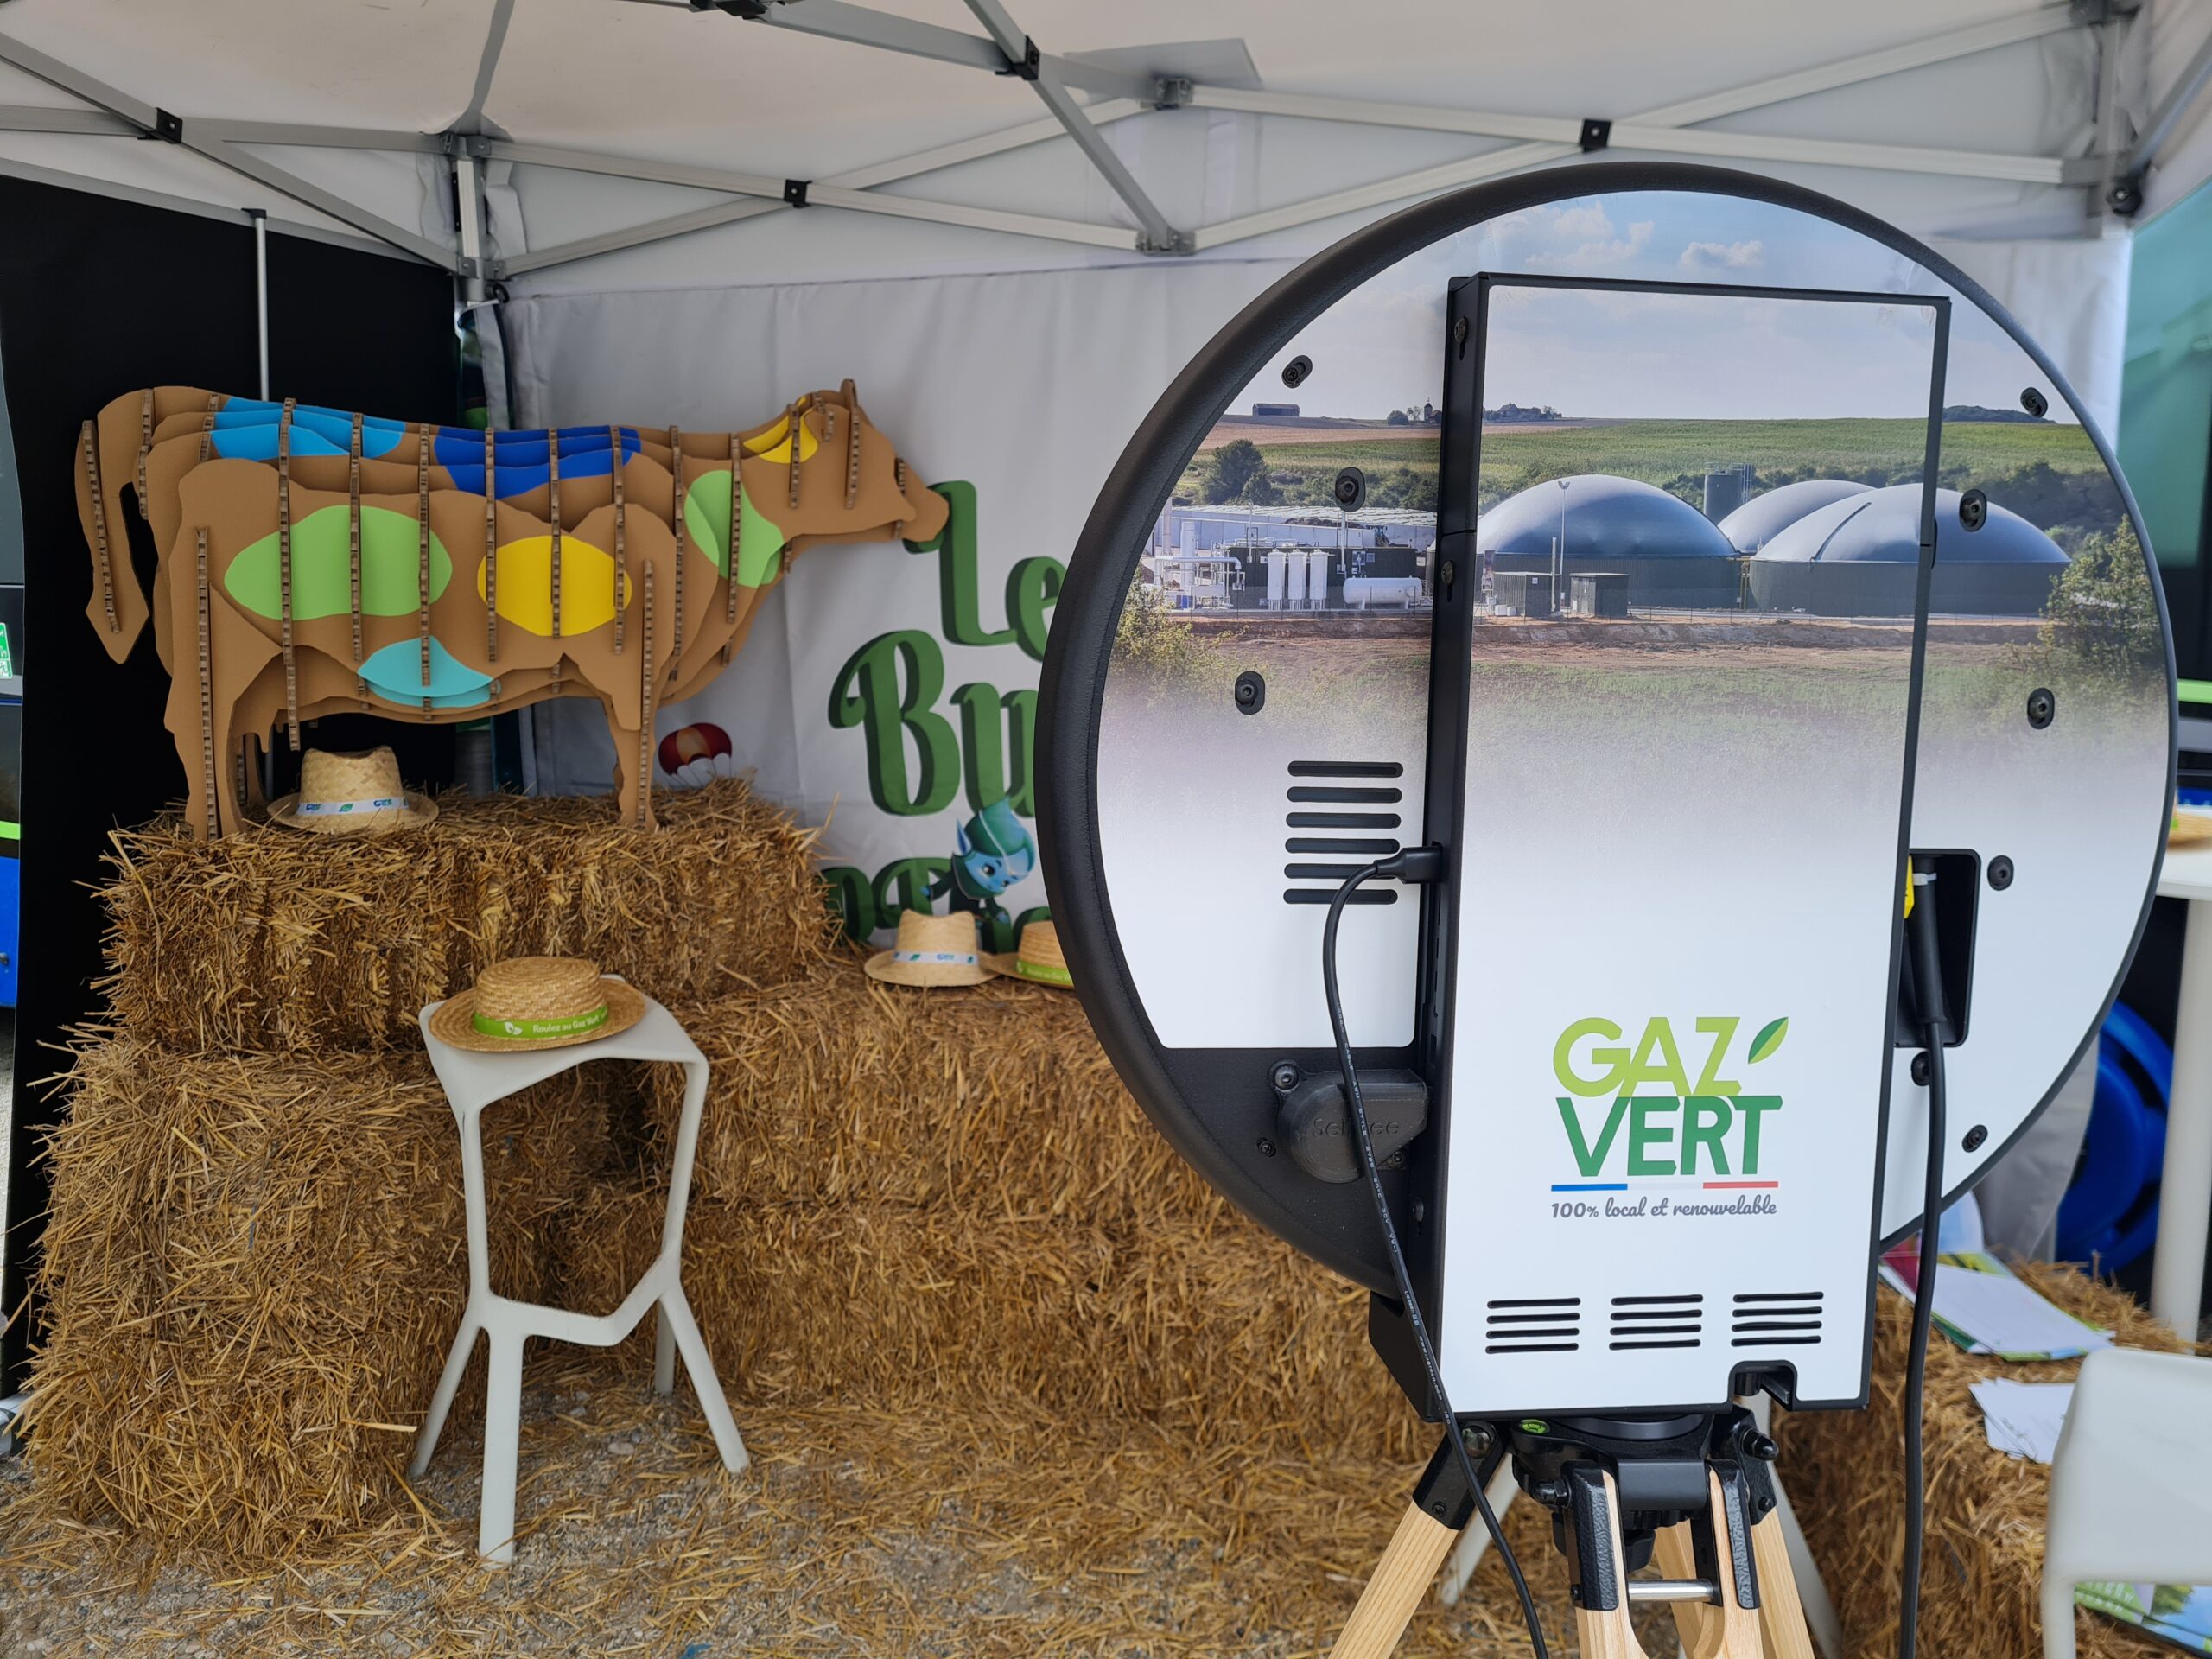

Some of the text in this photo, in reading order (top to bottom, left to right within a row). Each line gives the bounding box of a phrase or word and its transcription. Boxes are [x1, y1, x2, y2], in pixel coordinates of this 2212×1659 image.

[533, 1024, 561, 1033] Roulez
[573, 1020, 586, 1029] Gaz
[586, 1014, 600, 1026] Vert
[1553, 1016, 1742, 1098] GAZ
[1555, 1095, 1783, 1177] VERT
[1344, 1042, 1354, 1071] CABLE
[1358, 1108, 1367, 1136] STYLE
[1419, 1335, 1443, 1401] www.ugreen.com
[1551, 1194, 1777, 1218] 100% local et renouvelable
